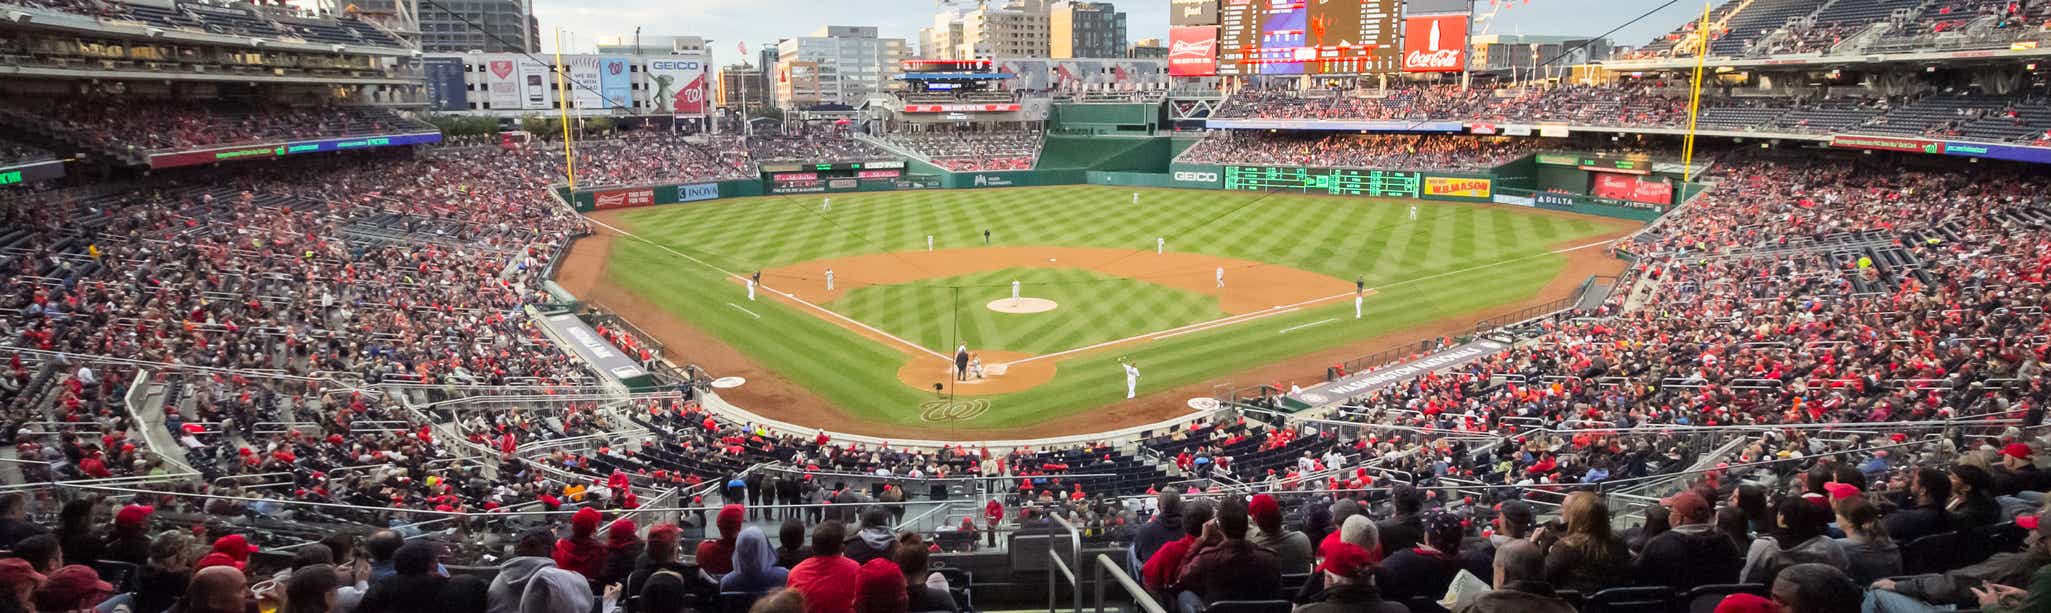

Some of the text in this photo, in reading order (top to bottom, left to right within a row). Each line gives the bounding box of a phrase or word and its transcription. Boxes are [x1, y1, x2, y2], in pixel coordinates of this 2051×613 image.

[653, 61, 698, 70] GEICO
[1174, 171, 1218, 182] GEICO
[688, 184, 718, 197] INOVA
[1546, 195, 1573, 206] DELTA
